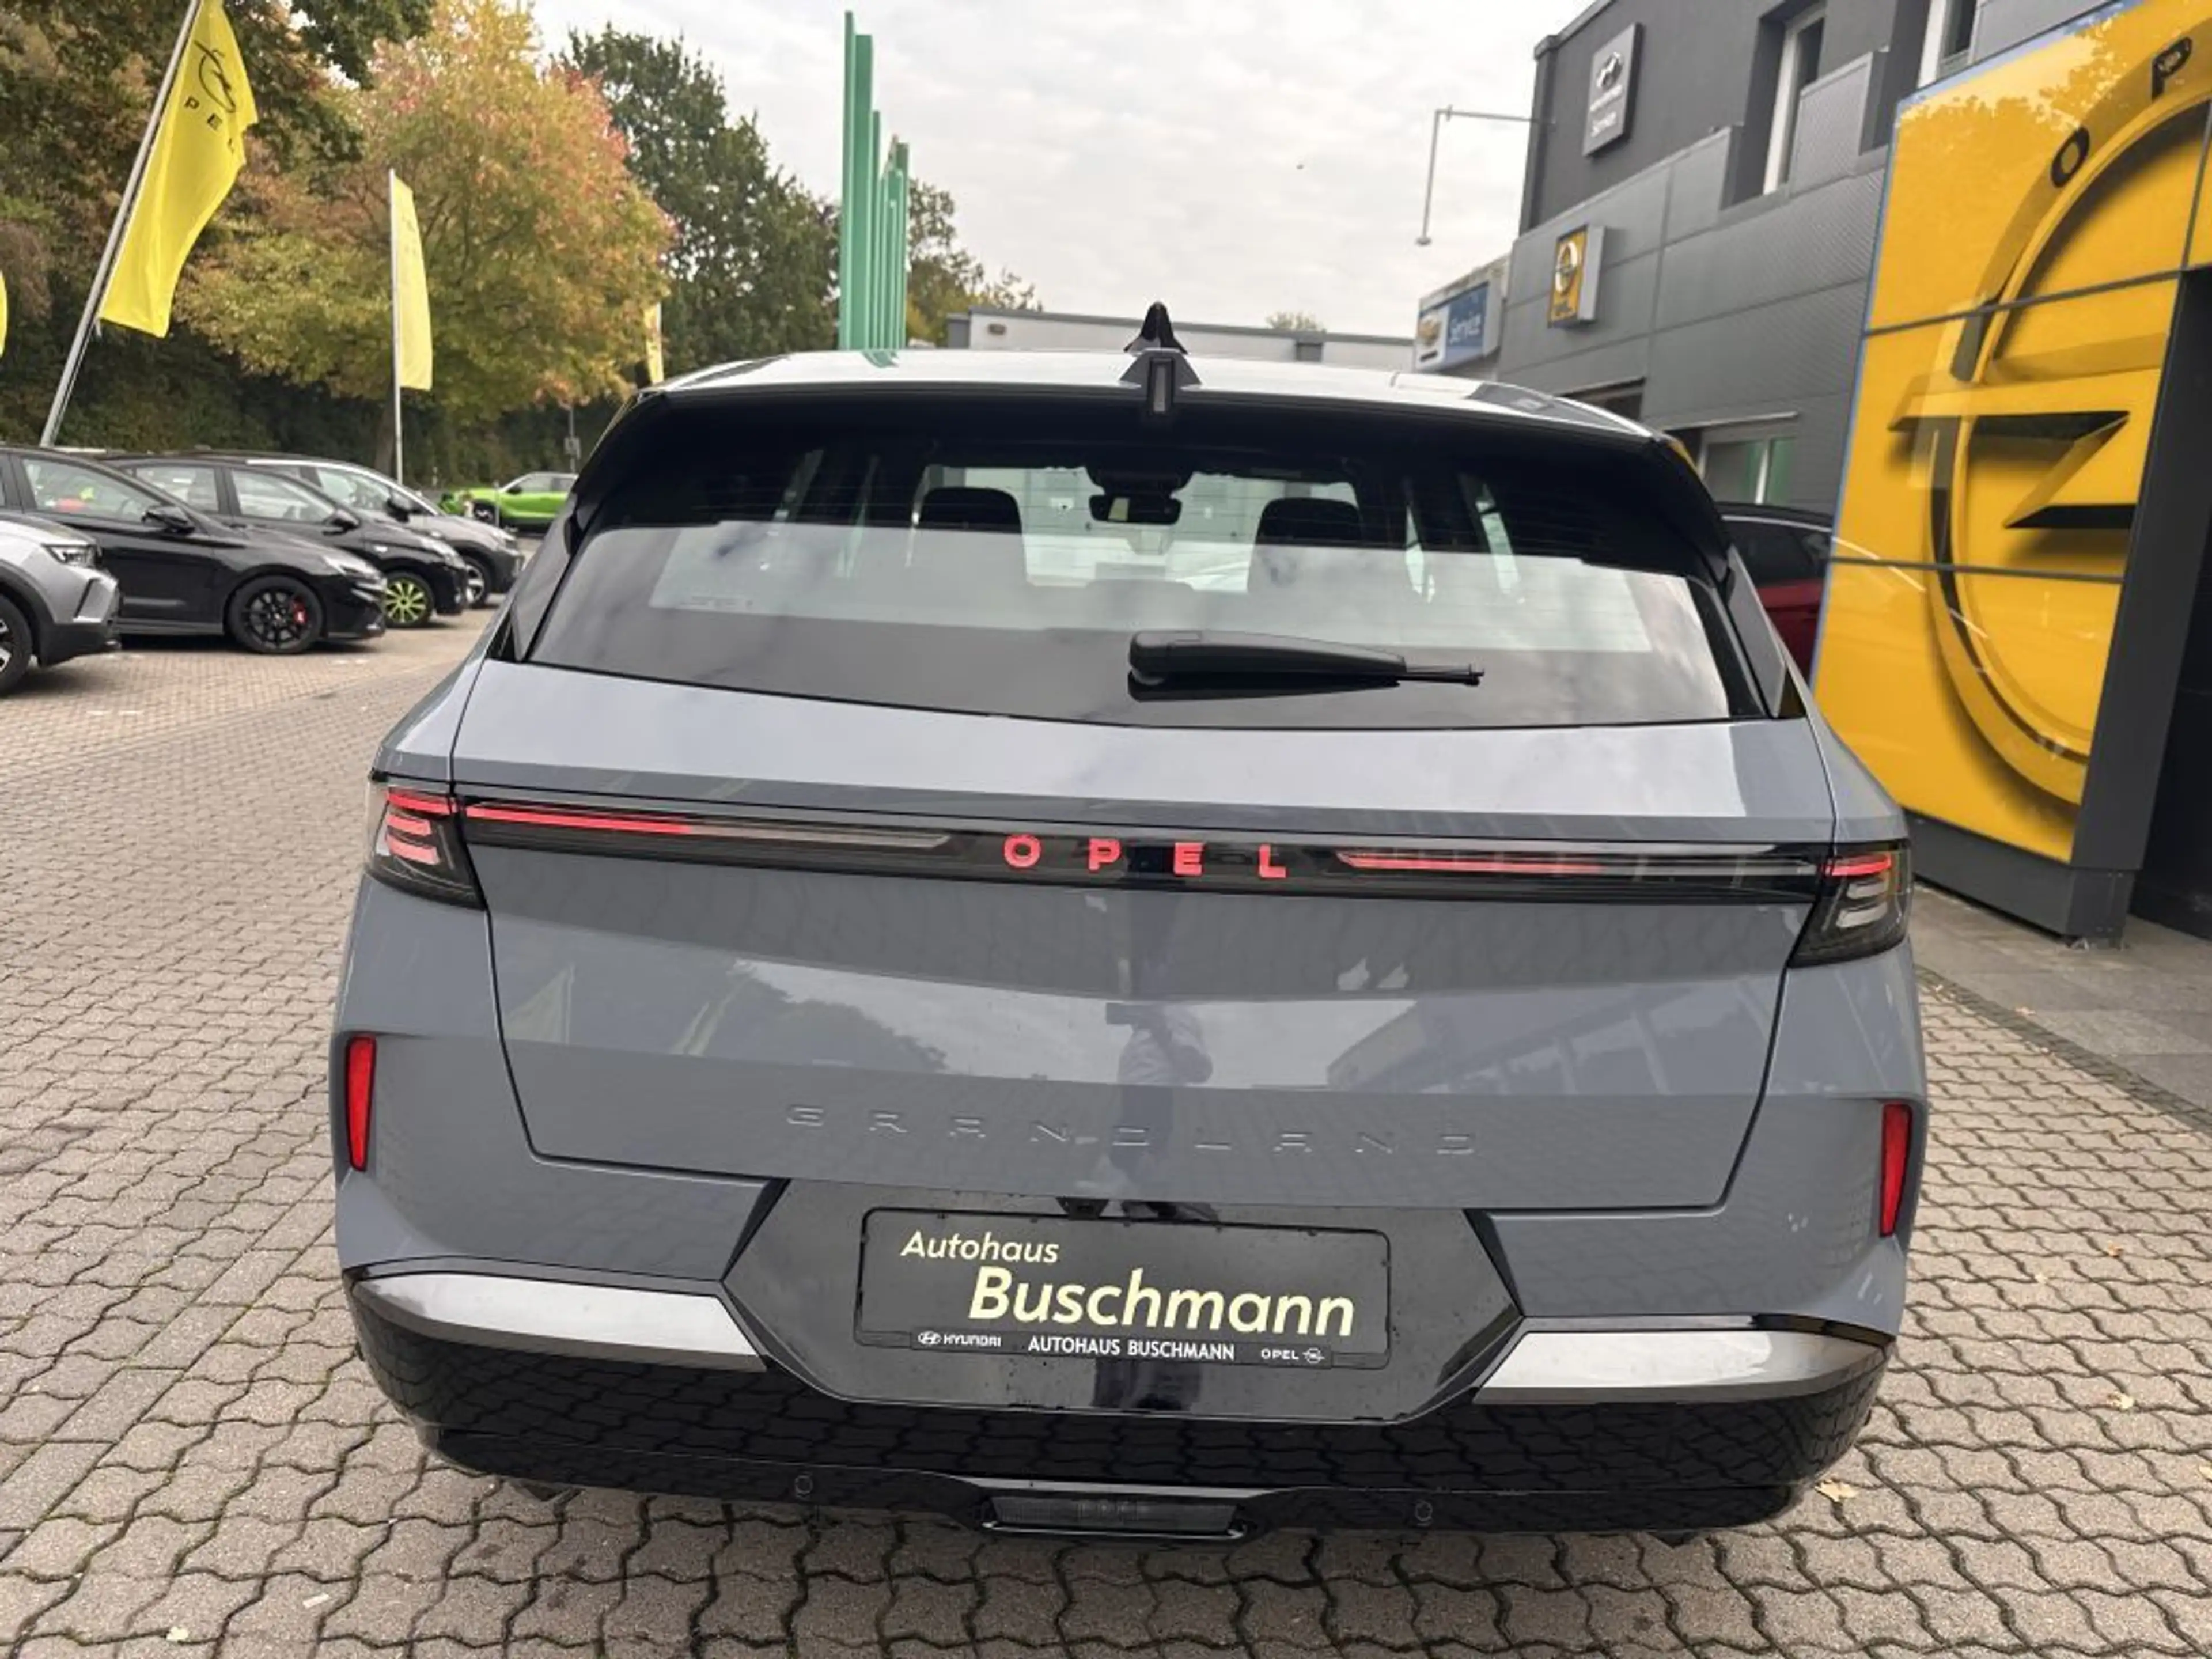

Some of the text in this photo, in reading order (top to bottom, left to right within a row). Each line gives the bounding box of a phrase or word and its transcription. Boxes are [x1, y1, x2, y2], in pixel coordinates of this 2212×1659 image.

[1003, 834, 1287, 878] OPEL
[786, 1104, 1475, 1156] GRANDLAND
[900, 1230, 1060, 1263] Autohaus
[968, 1266, 1355, 1336] Buschmann
[943, 1335, 1002, 1348] HYUNDAI
[1028, 1335, 1236, 1361] AUTOHAUS BUSCHMANN
[1260, 1347, 1300, 1361] OPEL
